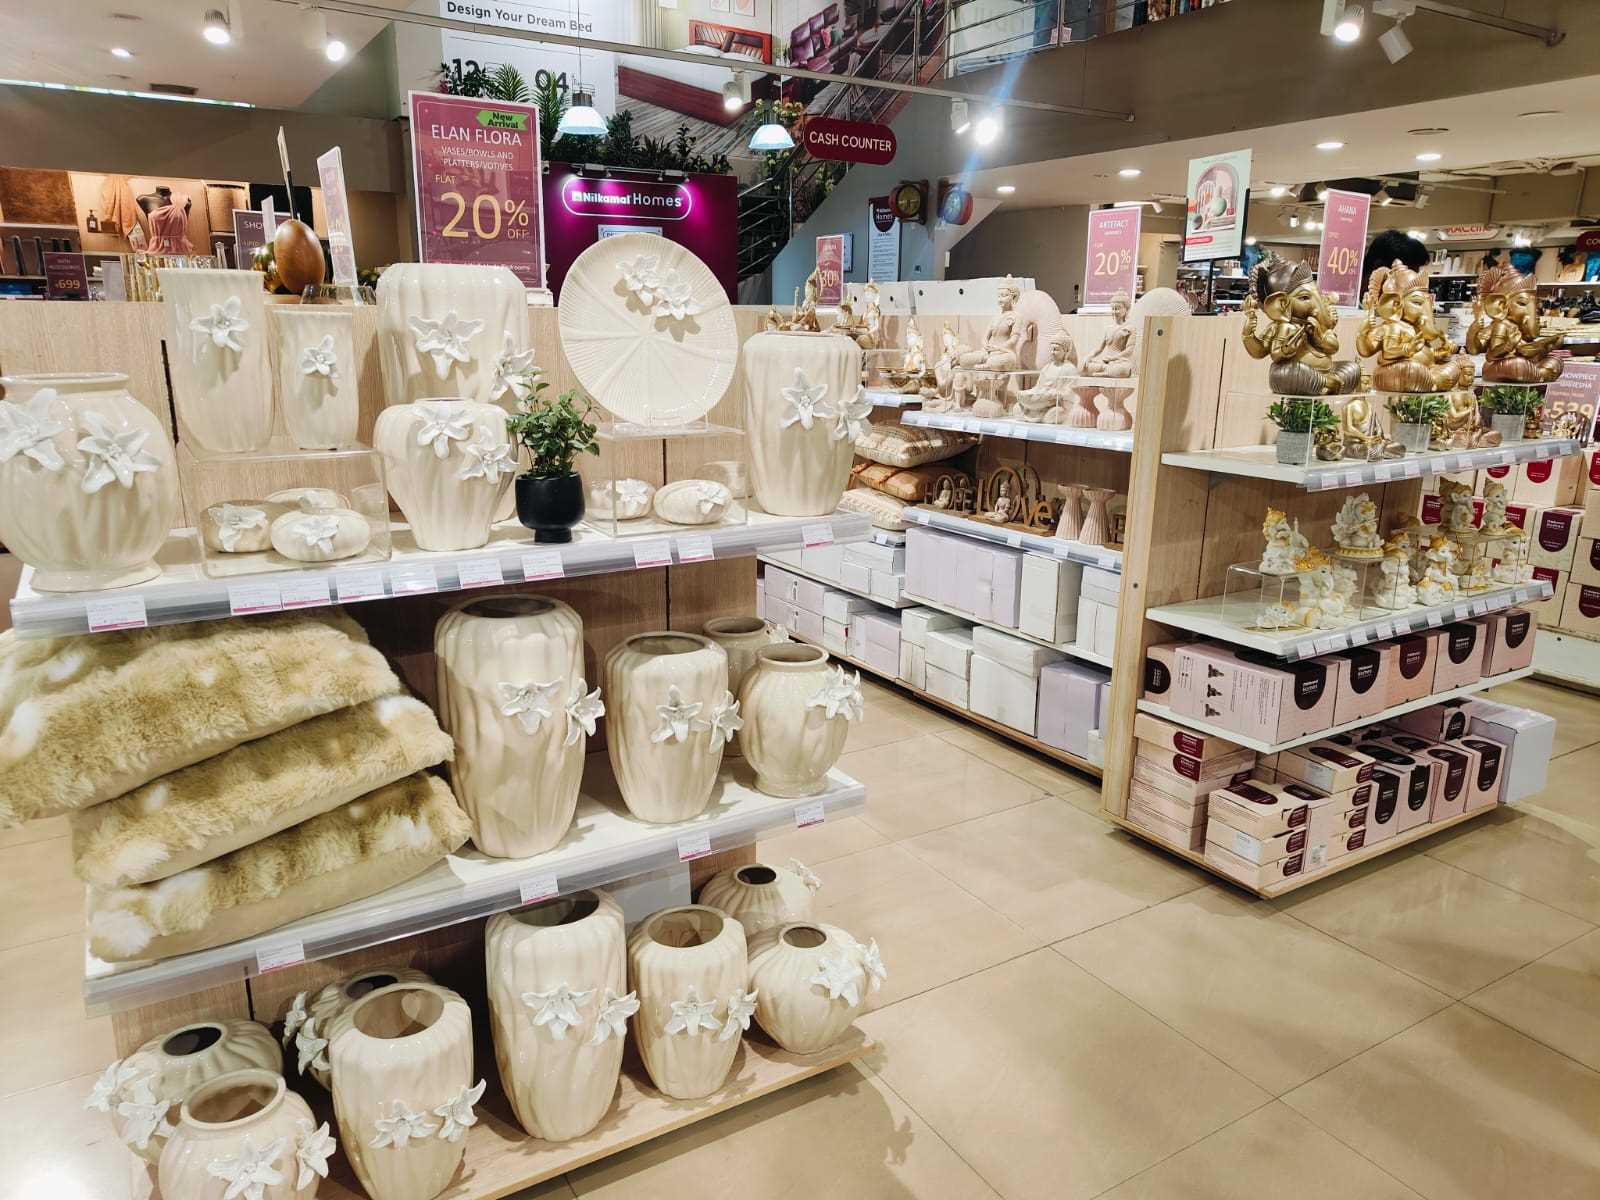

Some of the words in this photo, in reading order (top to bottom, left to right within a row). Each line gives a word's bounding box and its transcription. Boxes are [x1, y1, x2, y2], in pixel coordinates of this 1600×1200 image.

[447, 2, 491, 18] Design
[496, 9, 523, 23] Your
[527, 13, 566, 29] Dream
[570, 22, 593, 33] Bed
[492, 111, 513, 121] New
[487, 119, 519, 129] Arrival
[431, 124, 470, 142] ELAN
[475, 129, 522, 147] FLORA
[809, 130, 839, 146] CASH
[841, 135, 892, 152] COUNTER
[497, 151, 514, 160] AND
[434, 174, 456, 185] FLAT
[583, 191, 631, 205] Nilkamal
[632, 192, 682, 208] Homes
[441, 191, 529, 240] 20%
[507, 228, 529, 240] OFF
